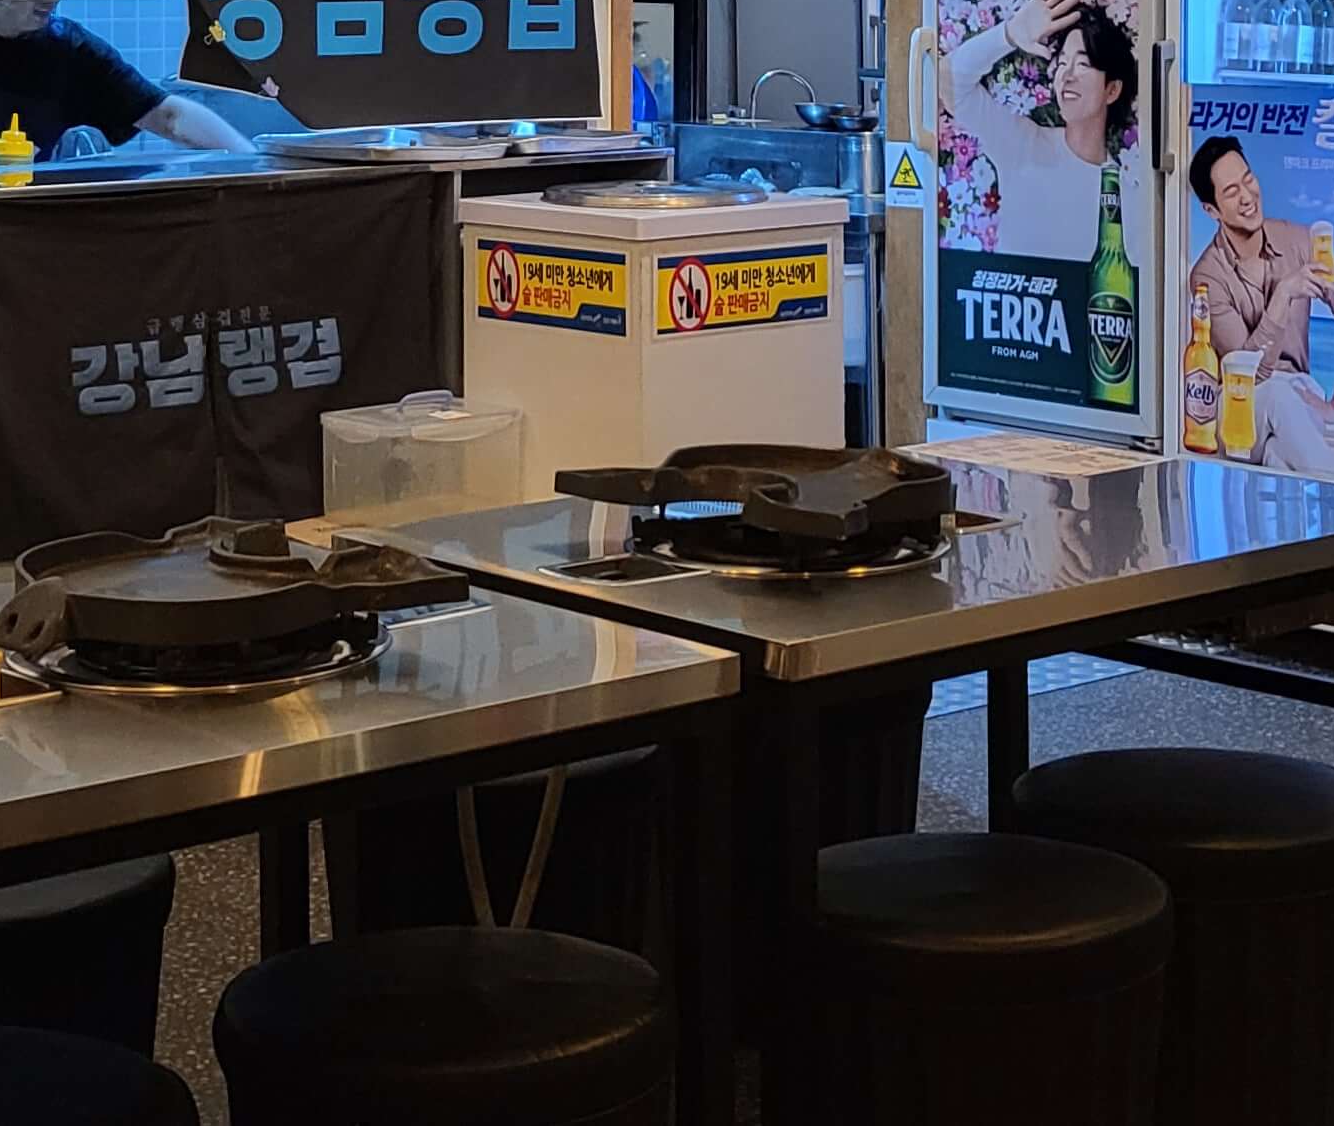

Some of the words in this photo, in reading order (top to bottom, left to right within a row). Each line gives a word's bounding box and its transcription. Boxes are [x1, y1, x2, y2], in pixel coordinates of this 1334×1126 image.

[1188, 101, 1256, 134] 라거의
[1262, 102, 1310, 136] 반전
[523, 262, 543, 283] 19세
[546, 264, 564, 286] 미만
[566, 265, 613, 293] 청소년에게
[715, 269, 738, 291] 19세
[742, 266, 763, 289] 미만
[765, 262, 815, 287] 청소년에게
[522, 284, 532, 306] 술
[534, 286, 571, 311] 판매금지
[714, 295, 725, 316] 술
[727, 290, 769, 315] 판매금지
[956, 289, 1072, 354] TERRA
[1088, 313, 1132, 338] TERRA
[71, 317, 343, 415] 강남랭겹
[991, 346, 1017, 359] FROM
[1019, 349, 1039, 362] AGM
[1186, 382, 1215, 406] Kelly
